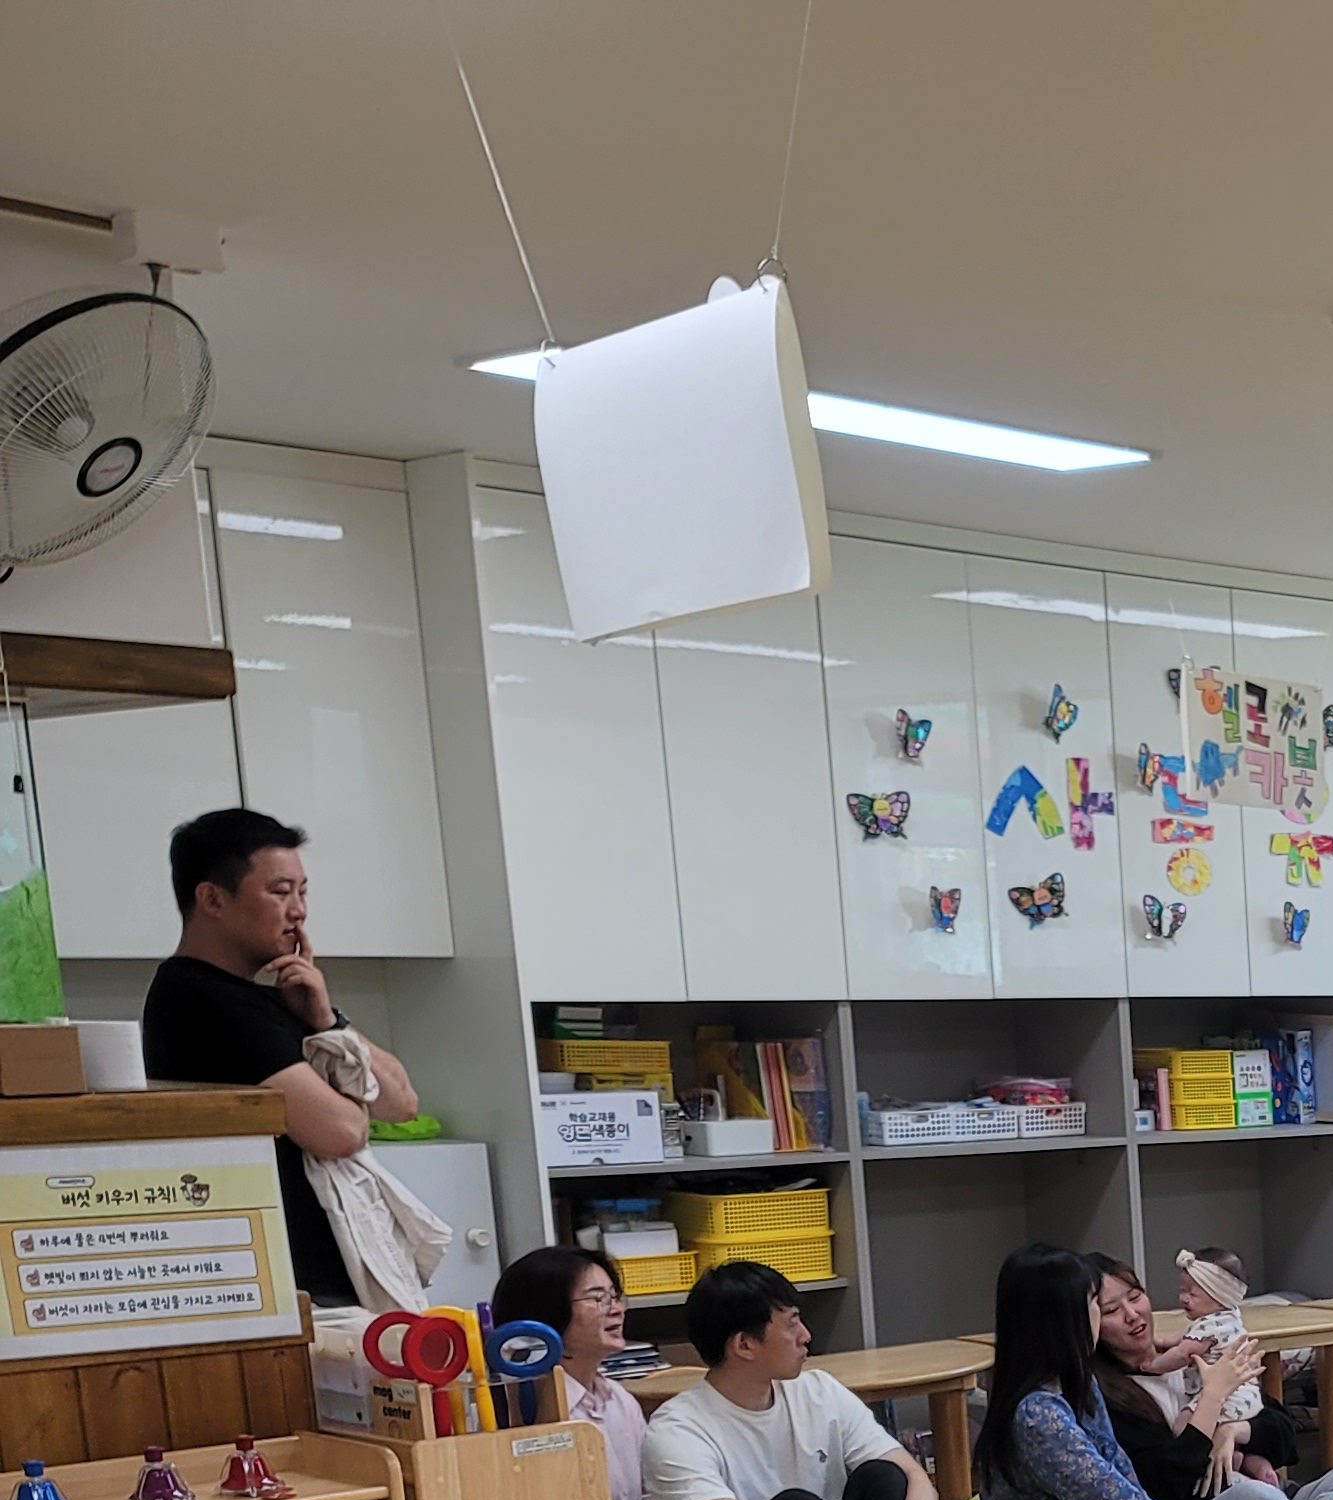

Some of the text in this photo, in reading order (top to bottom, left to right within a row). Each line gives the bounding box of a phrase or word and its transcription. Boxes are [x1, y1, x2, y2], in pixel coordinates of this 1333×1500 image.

[61, 1185, 177, 1208] 버섯 키우기 규칙!
[40, 1234, 71, 1248] 하루에
[103, 1266, 124, 1282] 않는
[127, 1265, 157, 1280] 서늘한
[161, 1264, 191, 1278] 곳에서
[194, 1261, 224, 1274] 키워요
[48, 1303, 80, 1318] 버섯이
[83, 1301, 114, 1314] 자라는
[118, 1298, 148, 1313] 모습에
[150, 1295, 180, 1311] 관심을
[184, 1294, 214, 1306] 가지고
[382, 1405, 412, 1421] center
